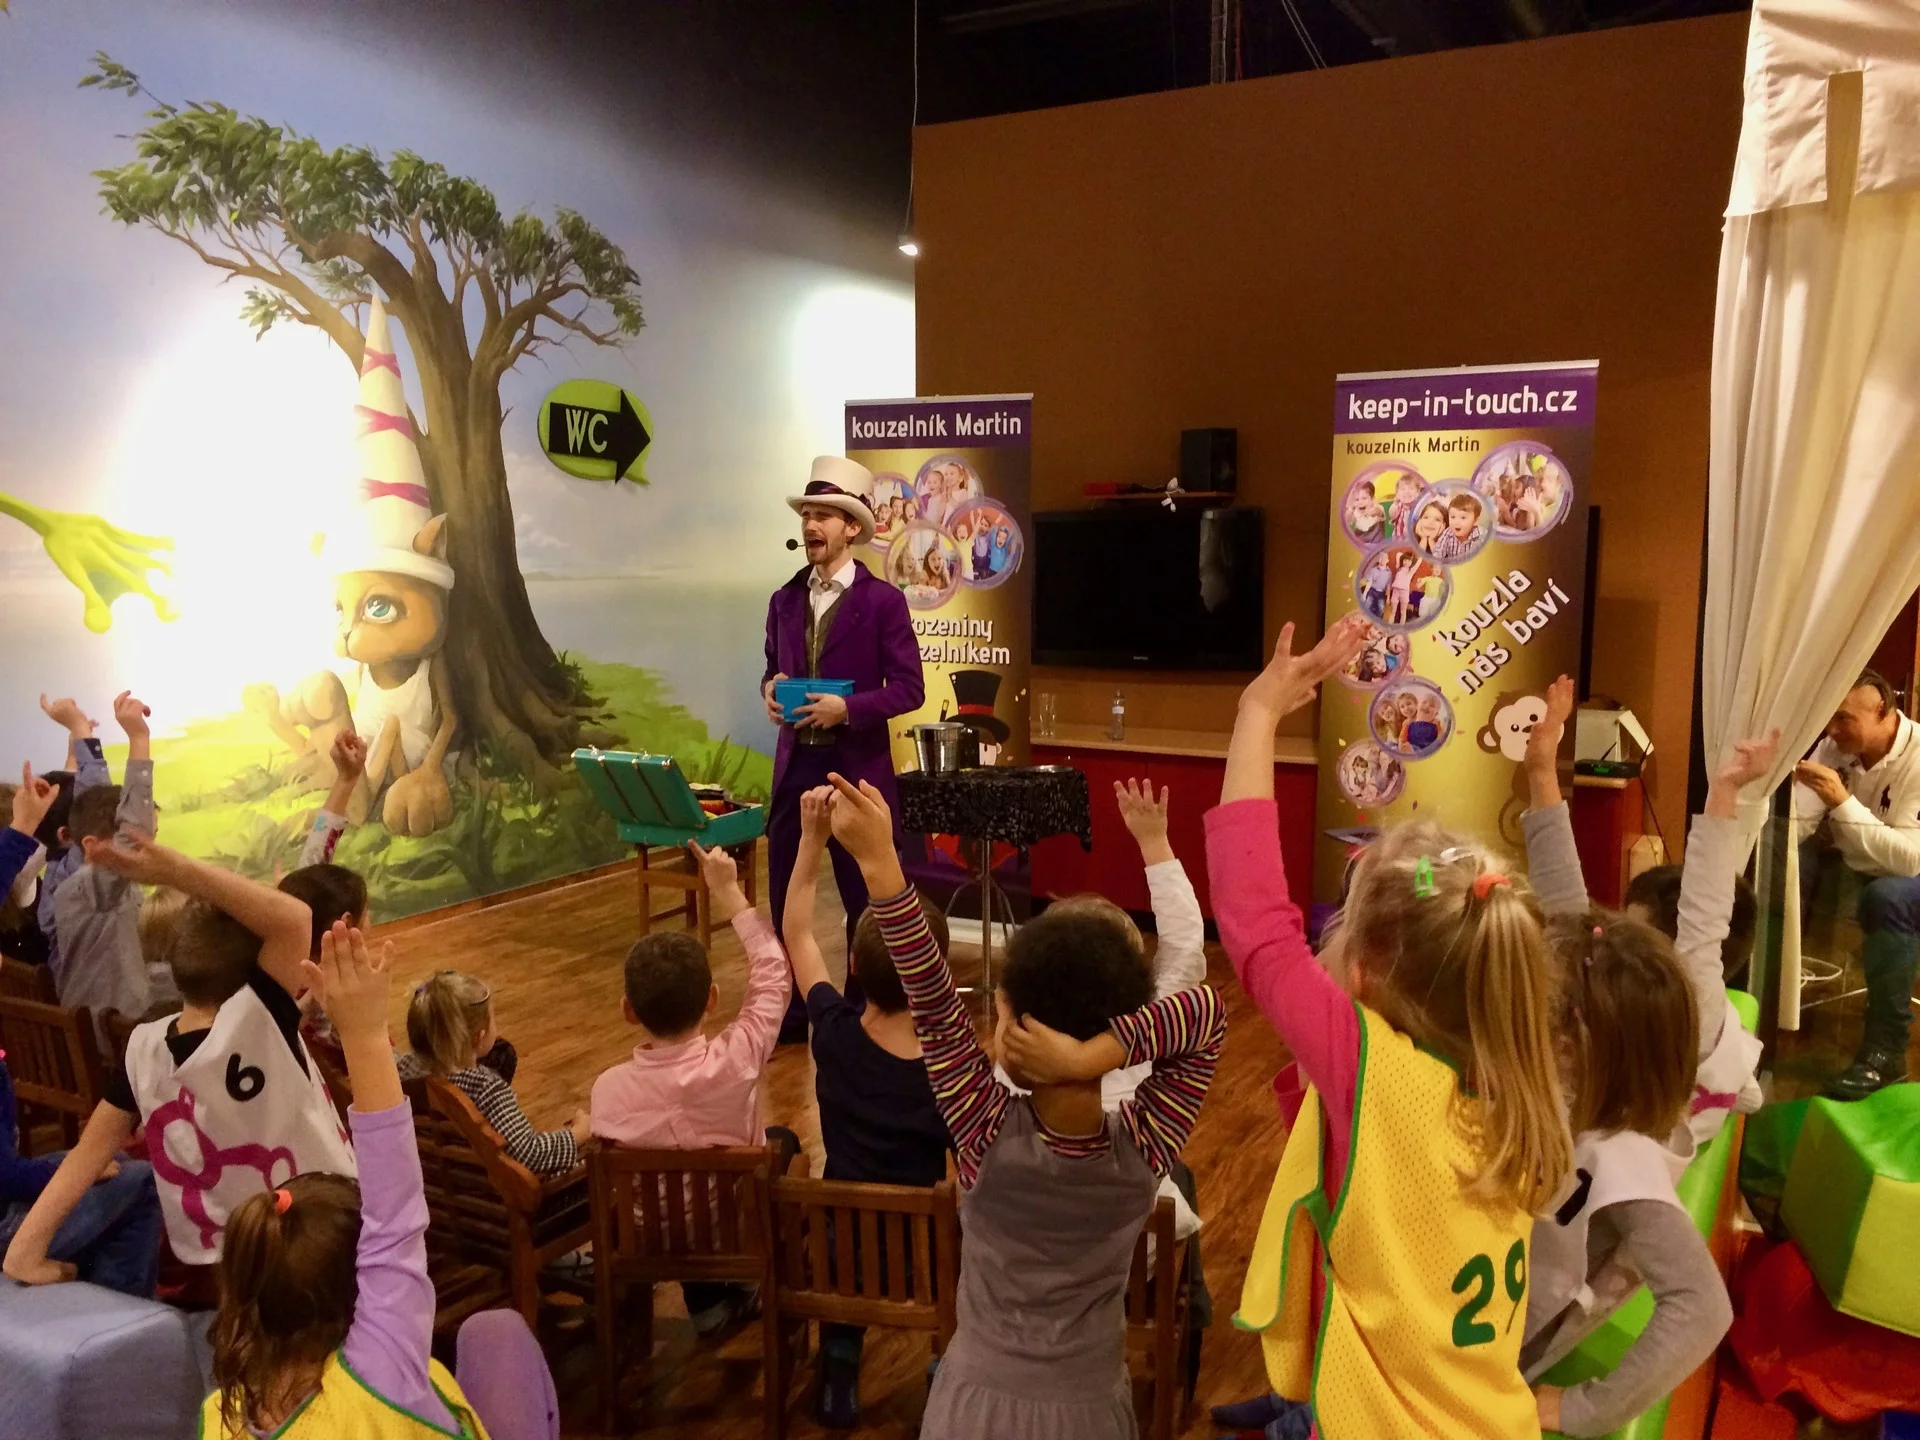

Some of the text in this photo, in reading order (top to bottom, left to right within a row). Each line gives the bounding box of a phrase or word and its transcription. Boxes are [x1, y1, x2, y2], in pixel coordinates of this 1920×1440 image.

[852, 411, 1022, 439] kouzelník Martin
[1348, 385, 1578, 425] keep-in-touch.cz
[565, 408, 609, 454] WC
[1346, 436, 1480, 455] kouzelník Martin
[1436, 569, 1532, 657] kouzla
[1455, 577, 1571, 695] nás baví
[225, 1053, 265, 1102] 6
[1451, 1238, 1527, 1348] 29
